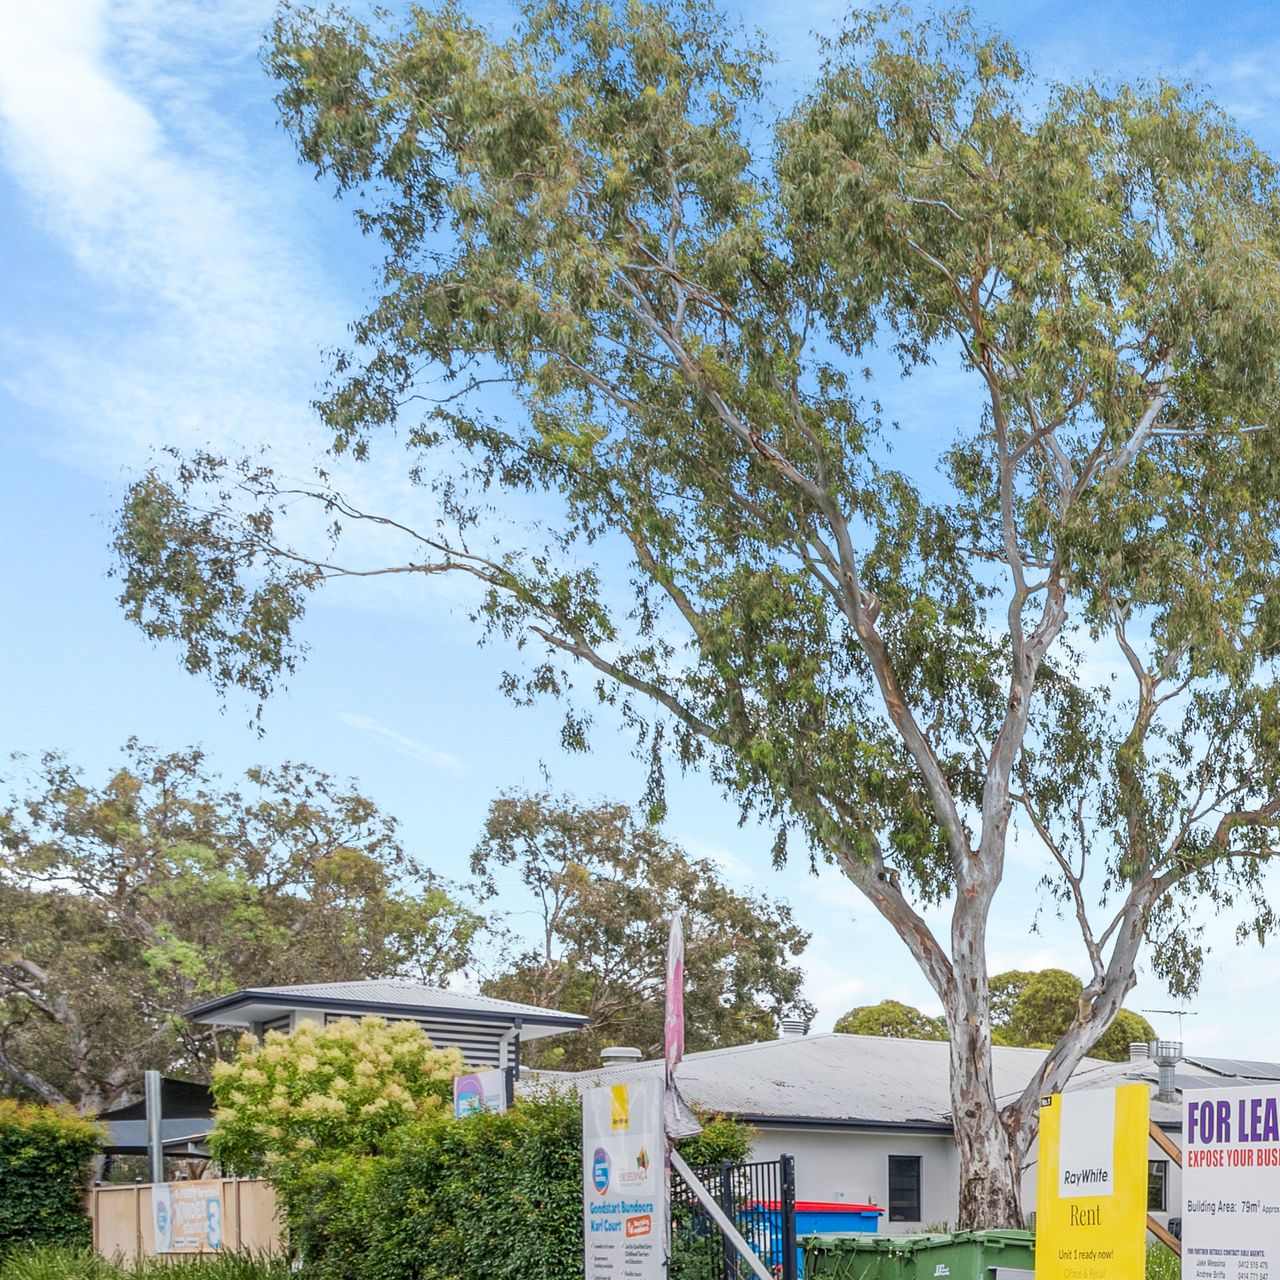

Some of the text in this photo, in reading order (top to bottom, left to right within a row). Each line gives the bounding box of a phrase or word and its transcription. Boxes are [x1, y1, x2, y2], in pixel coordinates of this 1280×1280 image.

[1188, 1100, 1231, 1144] FOR
[1188, 1149, 1224, 1168] EXPOSE
[1227, 1148, 1254, 1167] YOUR
[590, 1199, 654, 1215] Goodstart Bundoora
[1187, 1200, 1216, 1215] Building
[1217, 1200, 1237, 1213] Area:
[1069, 1204, 1102, 1227] Rent
[604, 1219, 622, 1232] Court
[1058, 1249, 1114, 1262] Unit 1 ready now!
